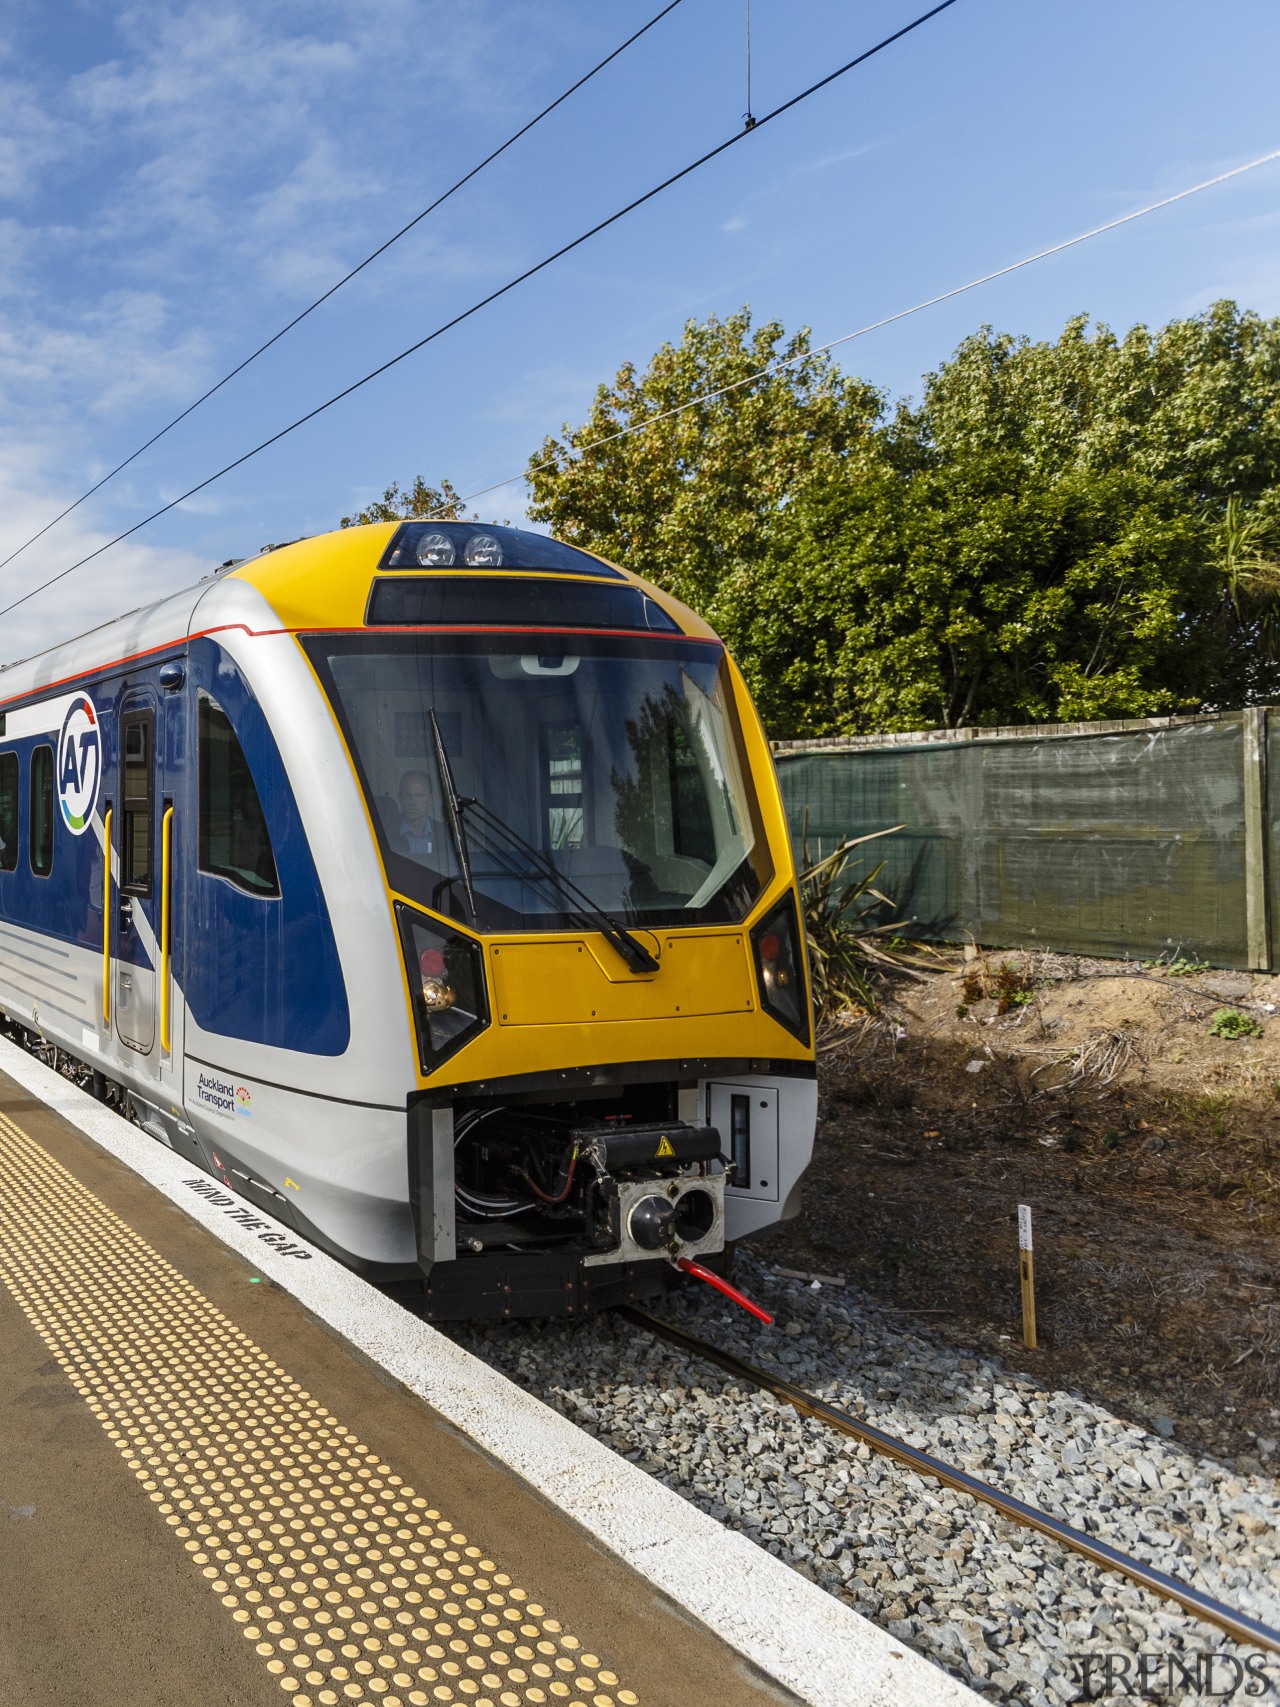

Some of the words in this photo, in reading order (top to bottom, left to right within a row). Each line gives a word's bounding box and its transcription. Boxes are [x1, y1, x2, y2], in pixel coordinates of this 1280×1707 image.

[60, 730, 97, 794] AT
[197, 1085, 235, 1111] Transport
[199, 1073, 234, 1097] Auckland
[182, 1179, 235, 1206] MIND
[223, 1207, 271, 1231] THE
[258, 1233, 313, 1260] GAP
